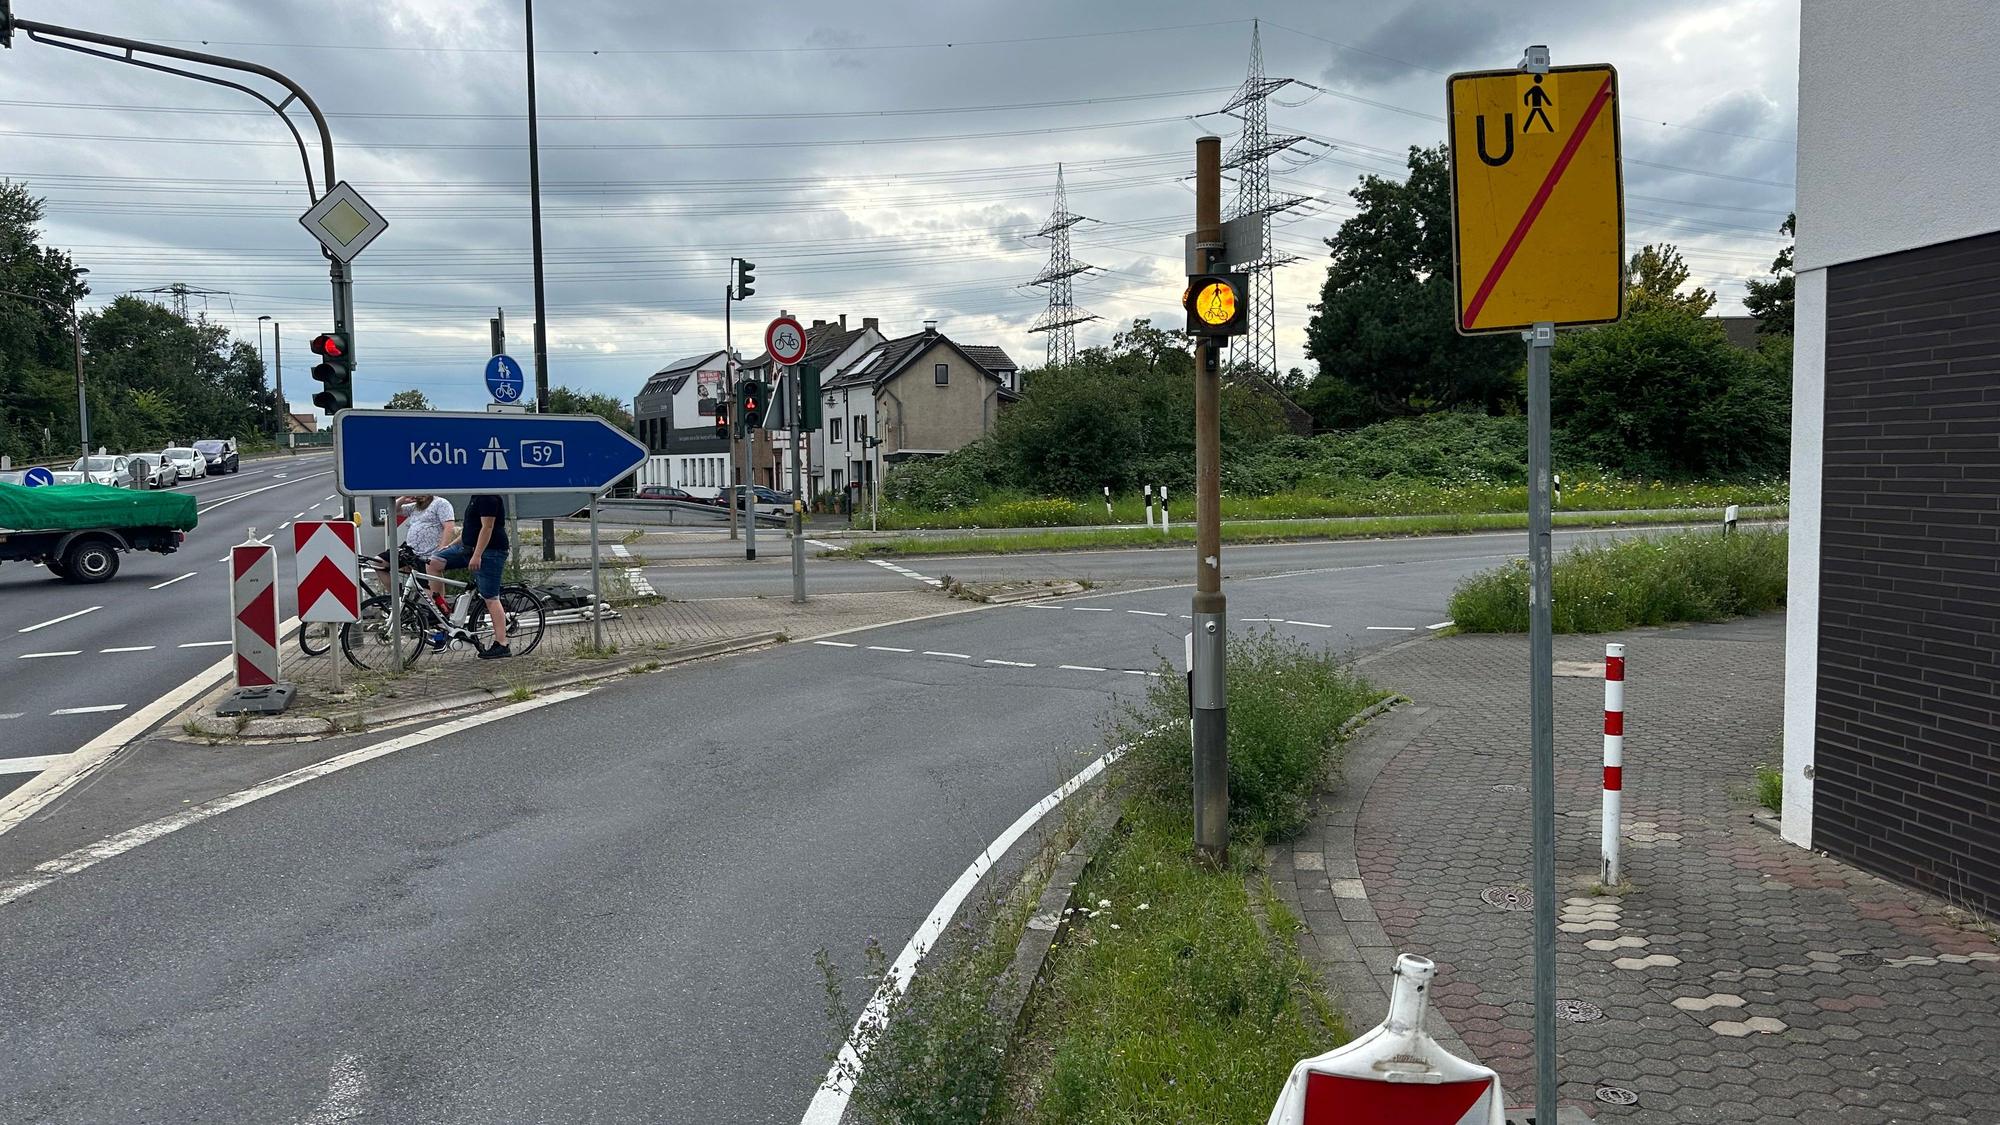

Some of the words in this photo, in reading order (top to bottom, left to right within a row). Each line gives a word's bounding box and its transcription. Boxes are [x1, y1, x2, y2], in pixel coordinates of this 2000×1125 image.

[1476, 113, 1514, 167] U
[410, 441, 468, 465] Köln
[532, 445, 553, 463] 59
